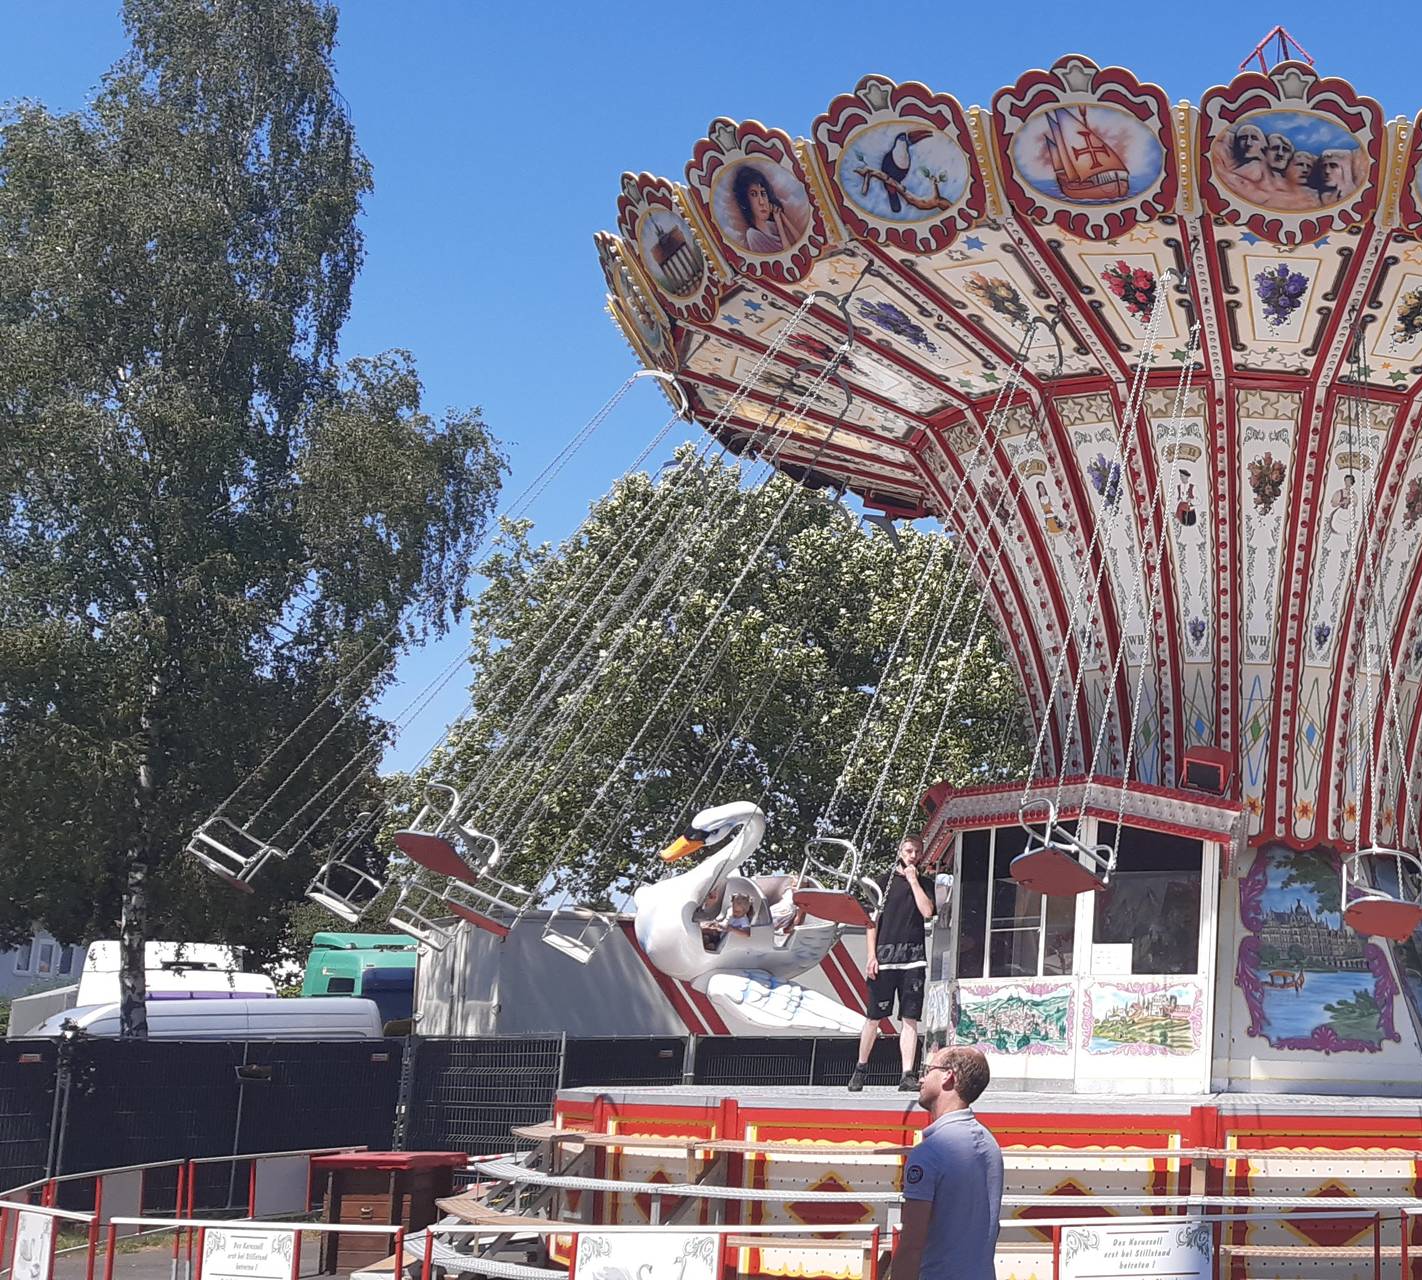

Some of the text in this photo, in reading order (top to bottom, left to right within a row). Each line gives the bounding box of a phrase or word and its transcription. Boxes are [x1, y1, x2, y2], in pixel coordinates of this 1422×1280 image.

[1128, 634, 1144, 646] WH
[1248, 635, 1267, 646] WH
[1121, 1248, 1132, 1258] bei
[1134, 1248, 1171, 1257] Stillstand
[1119, 1260, 1149, 1269] betreten
